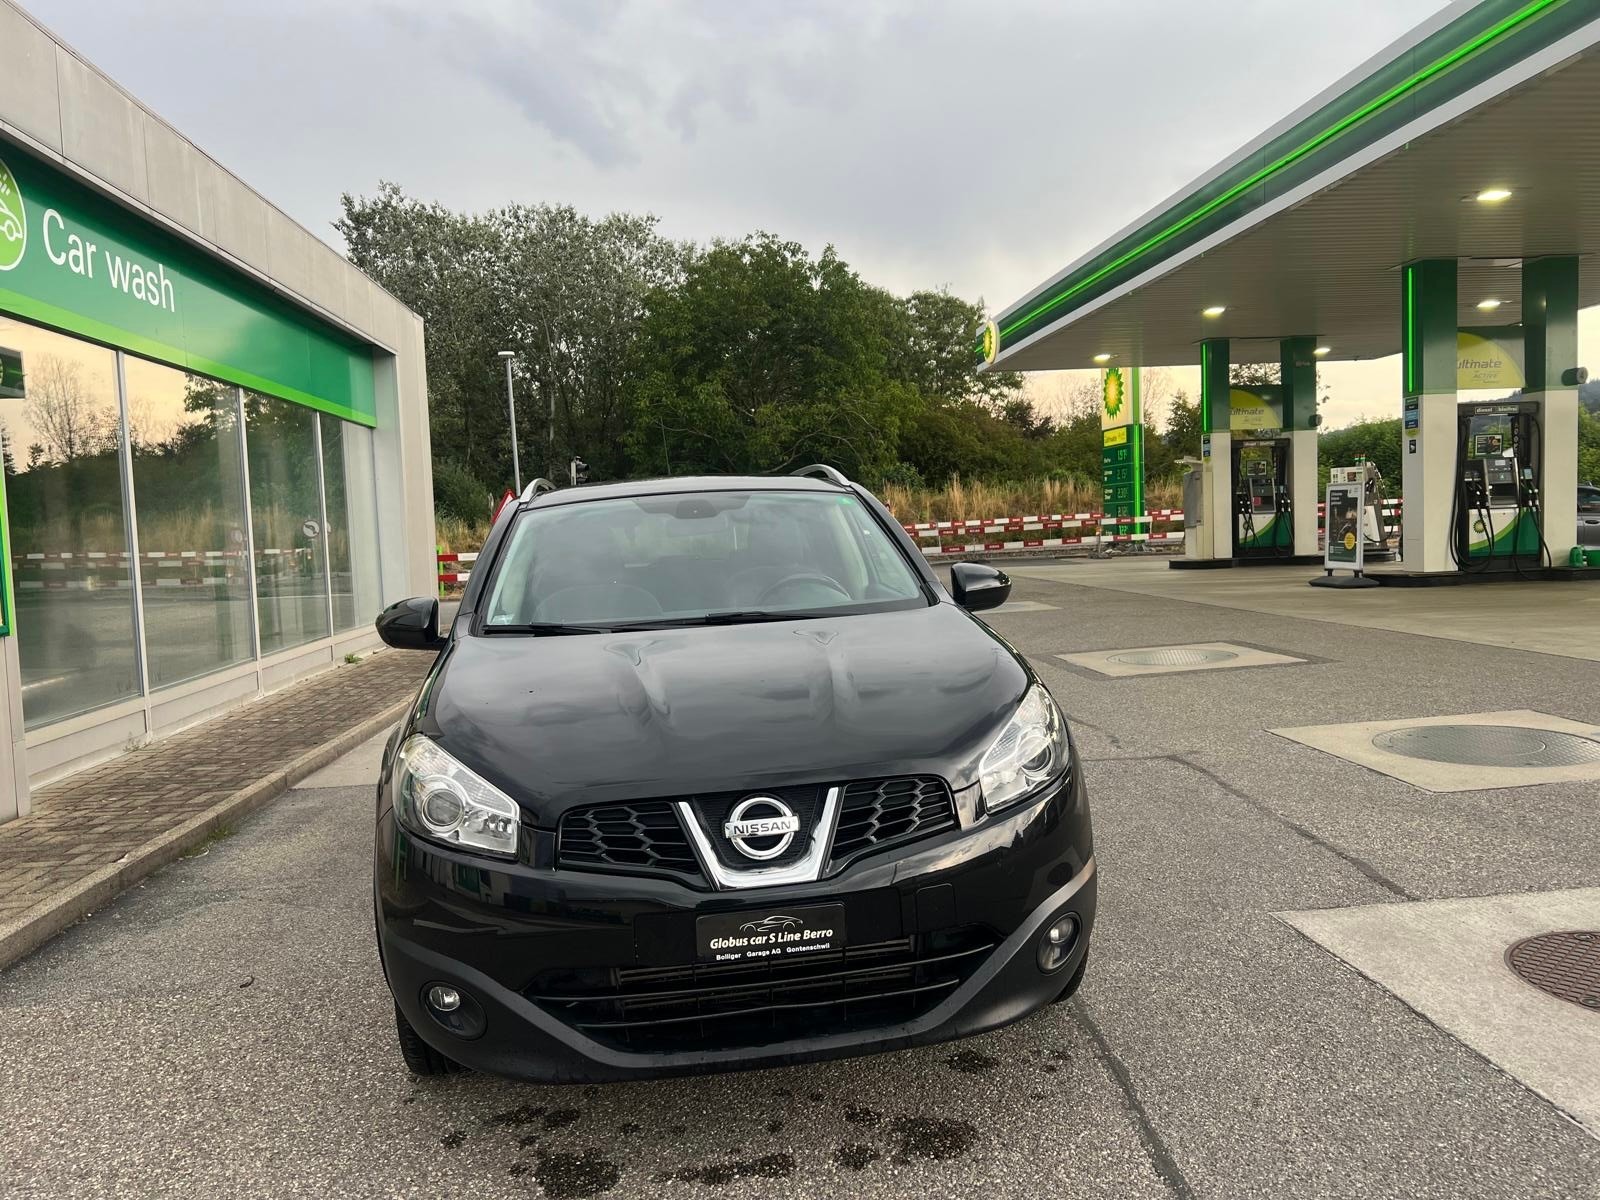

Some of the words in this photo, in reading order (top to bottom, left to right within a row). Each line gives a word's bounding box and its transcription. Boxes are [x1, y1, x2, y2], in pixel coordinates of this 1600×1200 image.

[43, 208, 96, 278] Car
[105, 250, 175, 312] wash
[733, 820, 791, 835] NISSAN
[710, 936, 748, 949] Globus
[750, 935, 768, 945] car
[769, 933, 776, 944] S
[777, 931, 801, 942] Line
[803, 929, 834, 940] Berro
[746, 949, 770, 958] Garage
[786, 942, 830, 953] Gontenschwil
